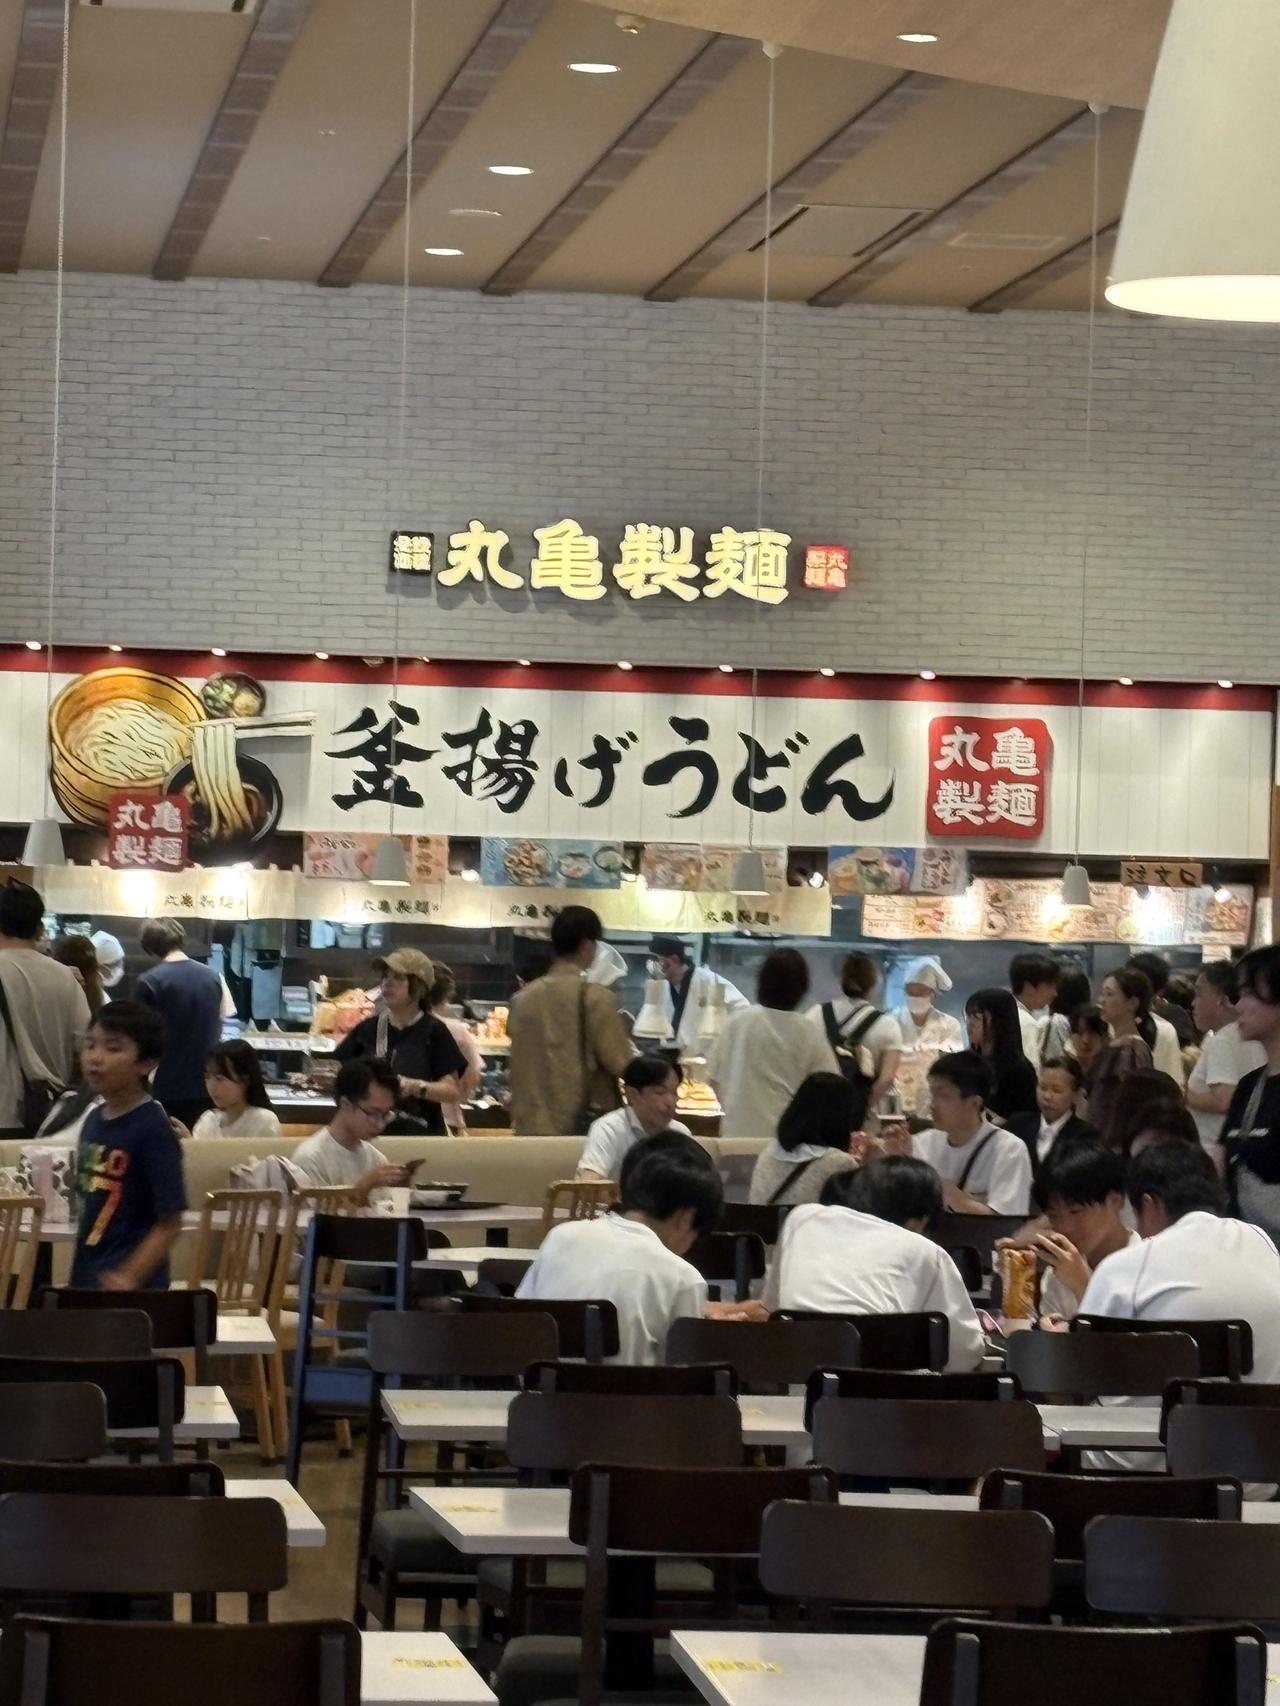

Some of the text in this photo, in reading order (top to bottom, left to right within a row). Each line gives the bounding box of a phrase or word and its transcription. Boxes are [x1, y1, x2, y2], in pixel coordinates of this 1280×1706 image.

[436, 518, 792, 604] 丸亀製麺
[324, 700, 896, 822] 釜揚げうどん
[934, 726, 1040, 776] 丸亀
[932, 779, 1040, 826] 製麺
